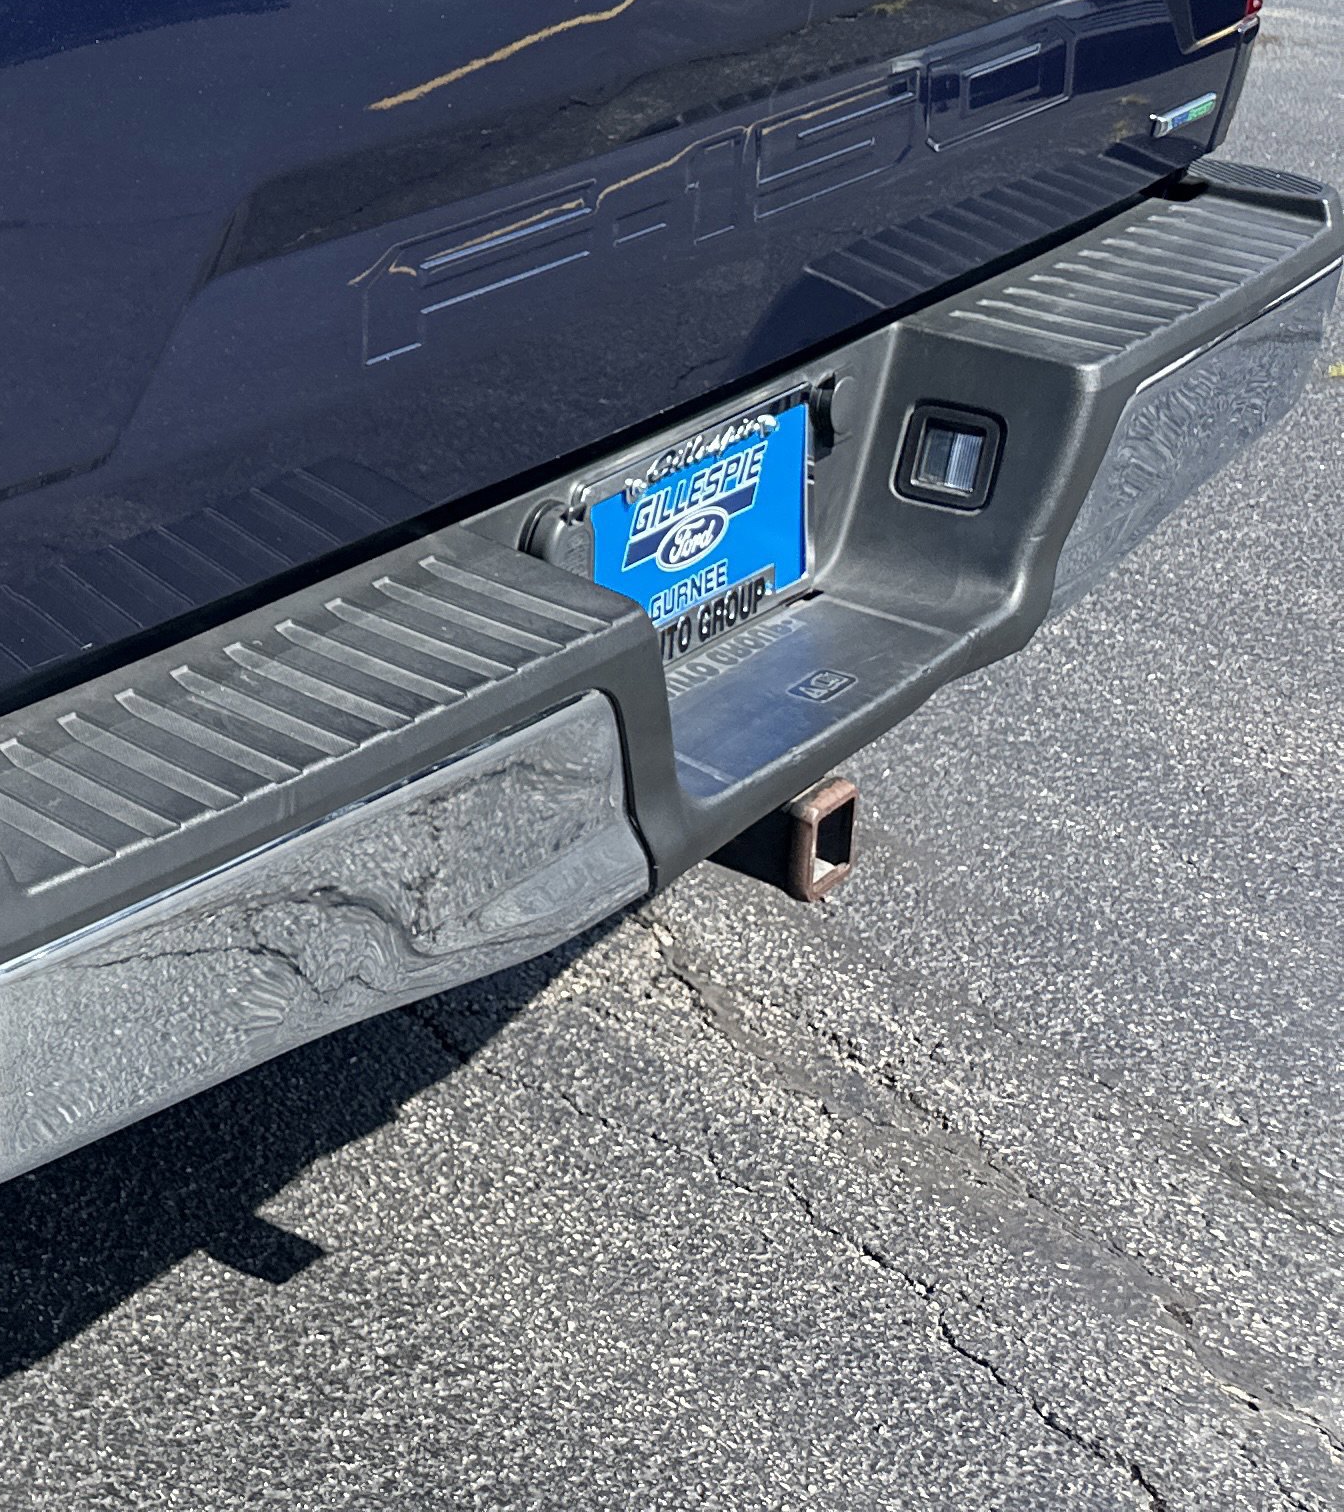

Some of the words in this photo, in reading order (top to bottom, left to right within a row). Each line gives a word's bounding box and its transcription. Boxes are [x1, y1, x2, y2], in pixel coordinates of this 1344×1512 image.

[631, 441, 768, 538] GILLESPIE
[669, 518, 717, 564] Ford
[649, 559, 729, 621] GURNEE
[698, 576, 766, 642] GROUP
